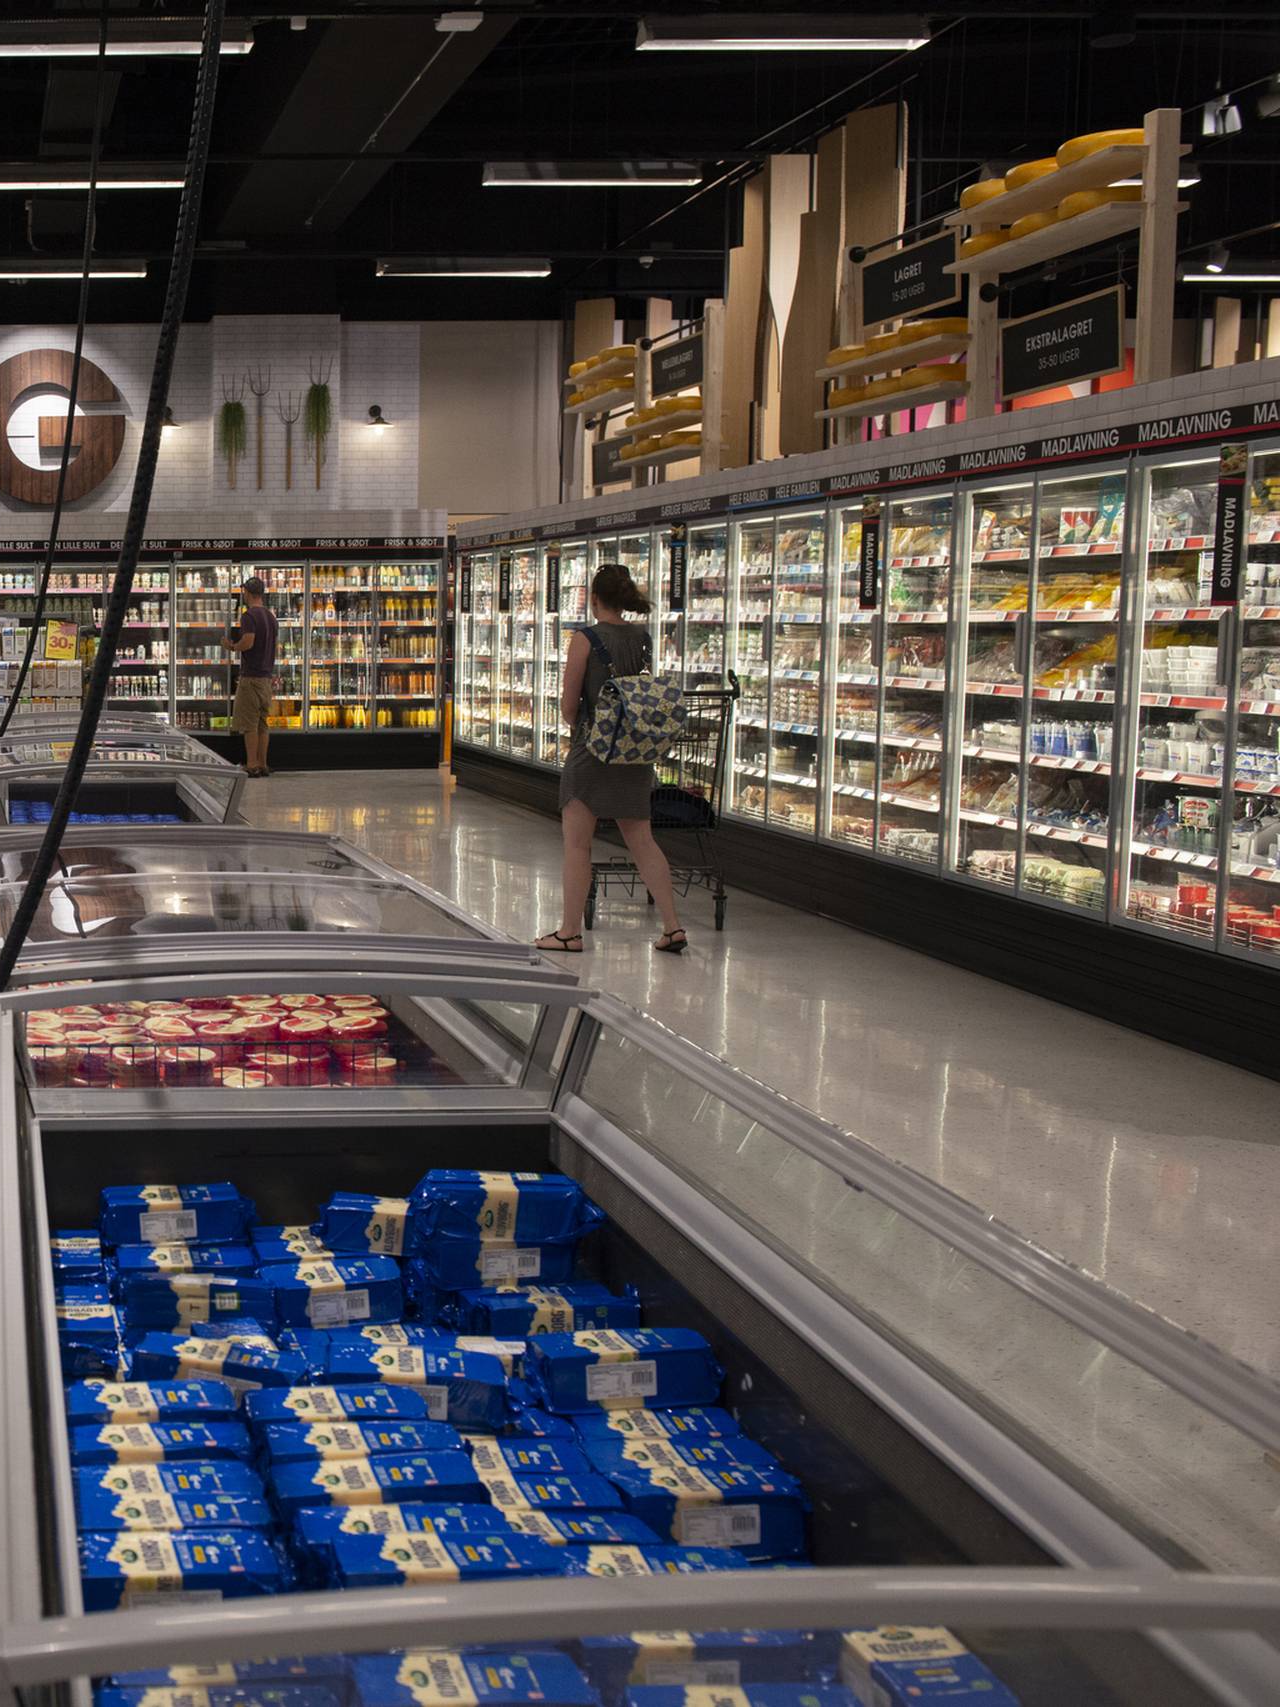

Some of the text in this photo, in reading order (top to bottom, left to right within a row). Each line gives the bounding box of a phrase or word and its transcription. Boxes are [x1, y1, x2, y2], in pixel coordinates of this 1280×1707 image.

[894, 261, 922, 284] LAGRET
[908, 281, 926, 297] UGER
[1025, 318, 1093, 353] EKSTRALAGRET
[1059, 347, 1080, 364] UGER
[1138, 410, 1232, 442] MADLAVNING
[1041, 428, 1119, 457] MADLAVNING
[959, 445, 1026, 471] MADLAVNING
[830, 470, 880, 491] MADLAVNING
[888, 459, 946, 481] MADLAVNING
[776, 481, 820, 498] HELE FAMILIEN
[44, 541, 100, 549] DN LILLE SULT
[181, 540, 235, 548] FRISK & SØDT
[248, 540, 302, 548] FRISK & SØDT
[316, 539, 369, 547] FRISK & SØDT
[384, 538, 438, 547] FRISK & SØDT
[1220, 497, 1236, 589] MADLAVNING
[864, 532, 874, 598] MADLAVNING
